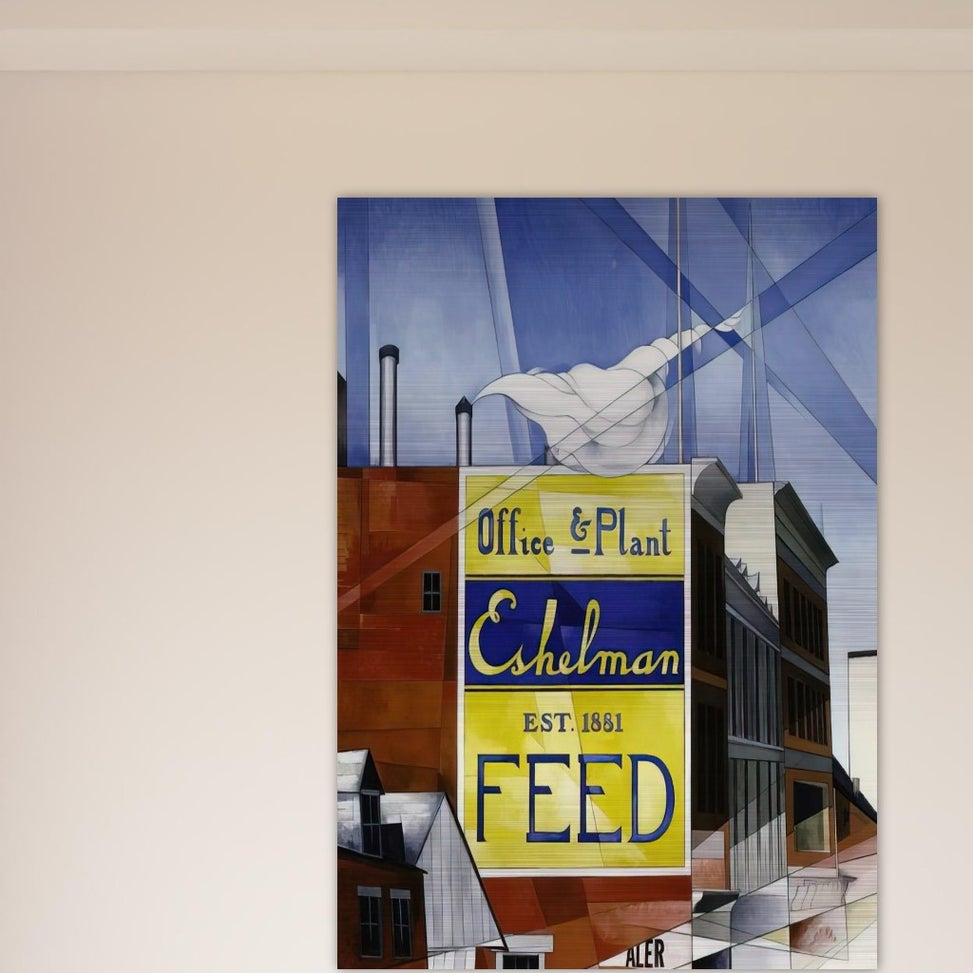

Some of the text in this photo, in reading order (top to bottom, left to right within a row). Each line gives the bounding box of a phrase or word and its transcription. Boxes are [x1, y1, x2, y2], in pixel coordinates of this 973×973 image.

[477, 507, 555, 556] Office
[468, 588, 679, 676] Eshelman
[523, 712, 624, 732] EST. 1881
[476, 752, 676, 843] FEED
[625, 938, 665, 968] ALER
